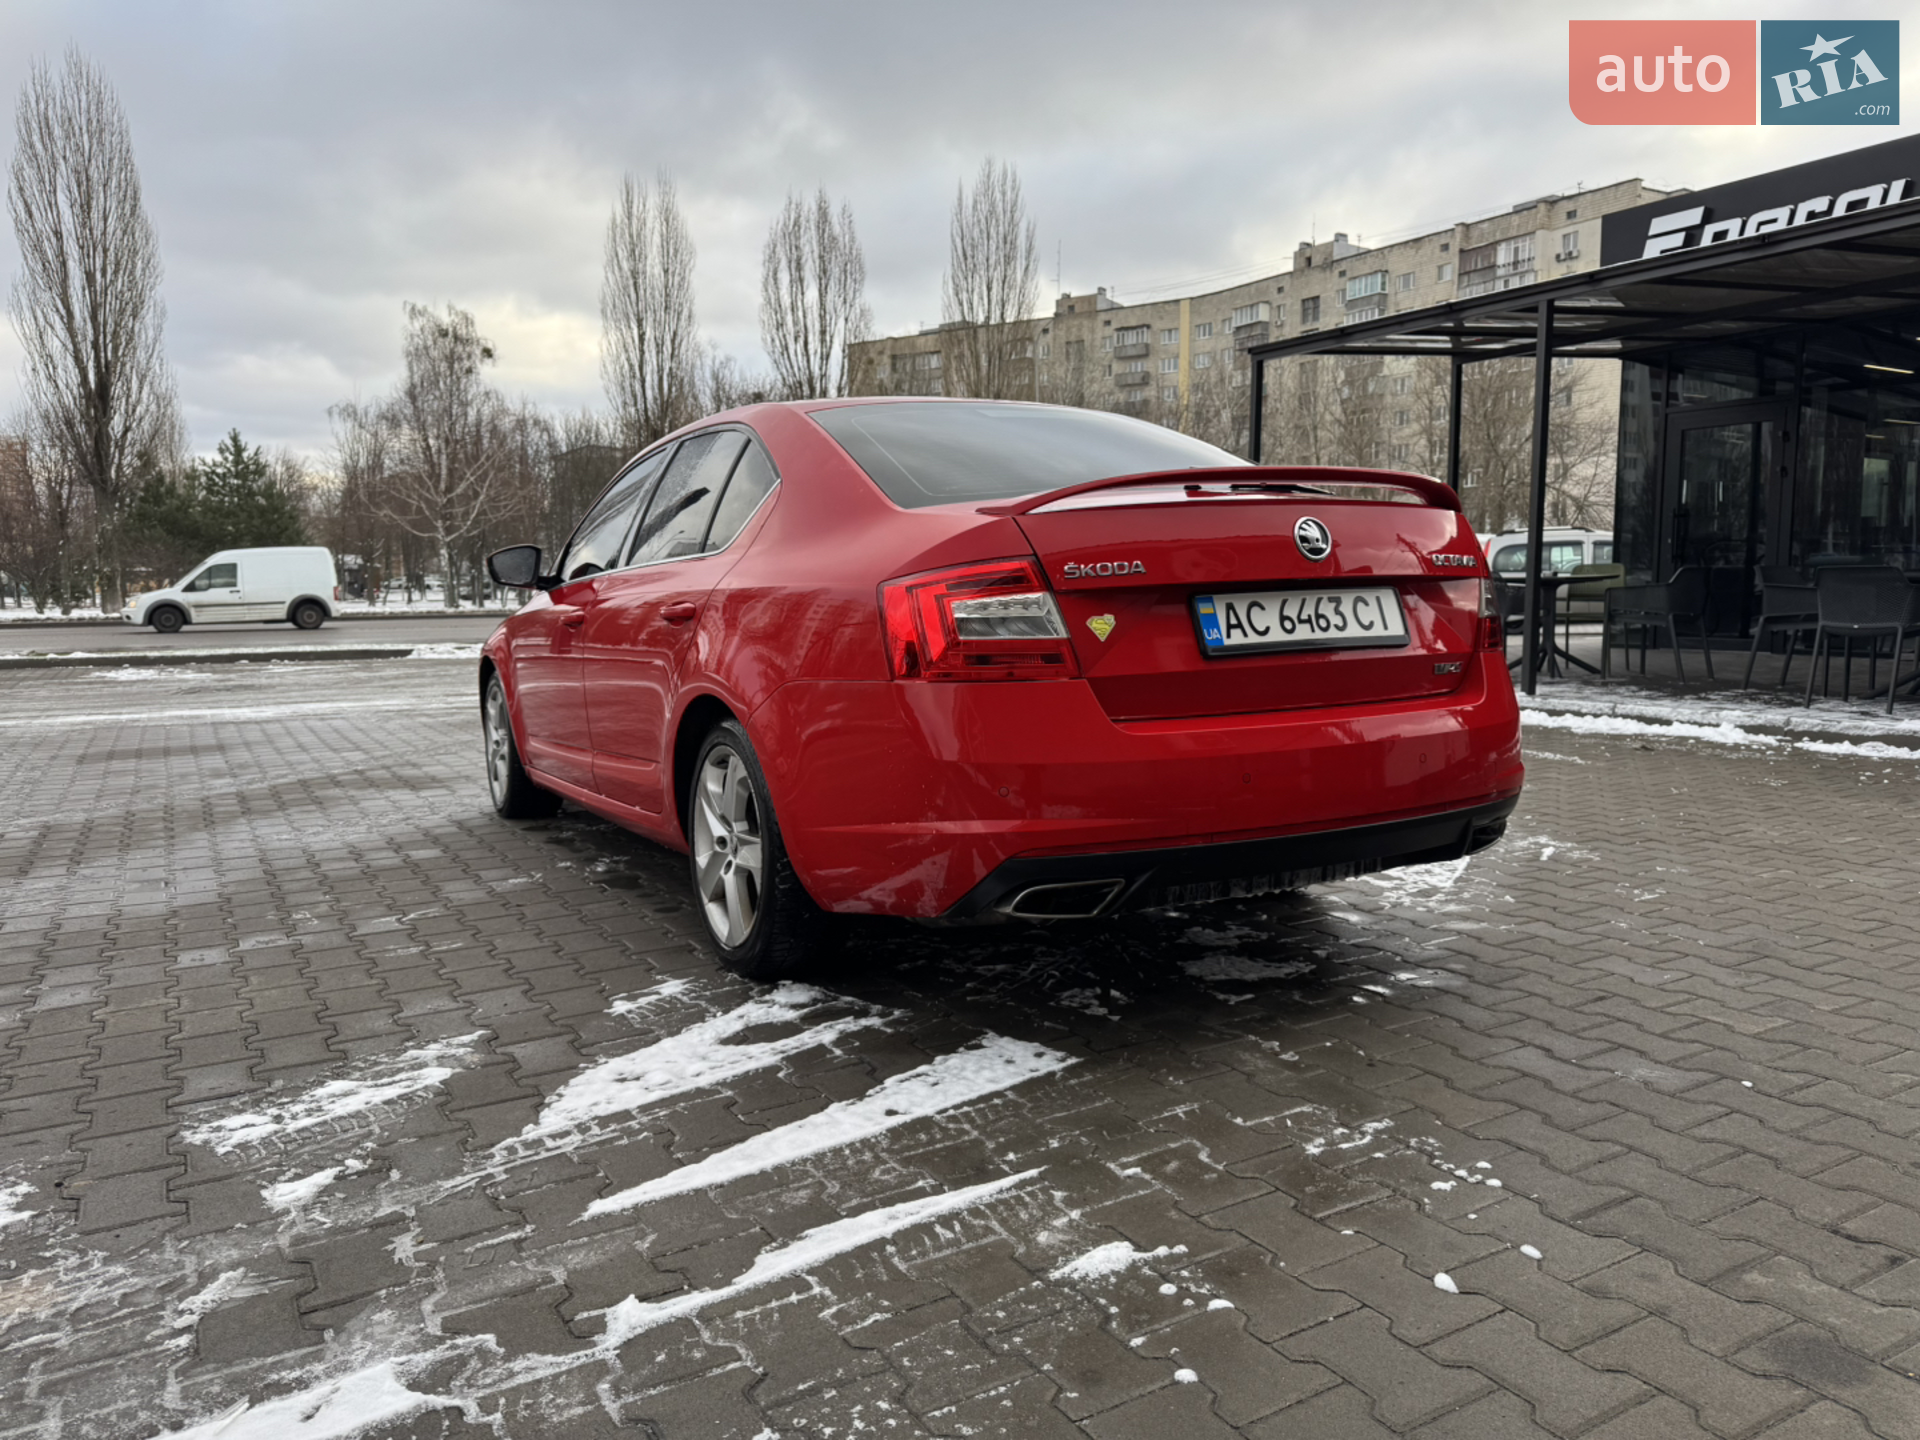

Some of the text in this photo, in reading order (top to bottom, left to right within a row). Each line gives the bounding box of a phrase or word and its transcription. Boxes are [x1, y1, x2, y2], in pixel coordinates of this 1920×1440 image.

[1063, 560, 1147, 579] ŠKODA
[1225, 595, 1389, 639] AC 6463 CI
[1204, 628, 1223, 641] UA
